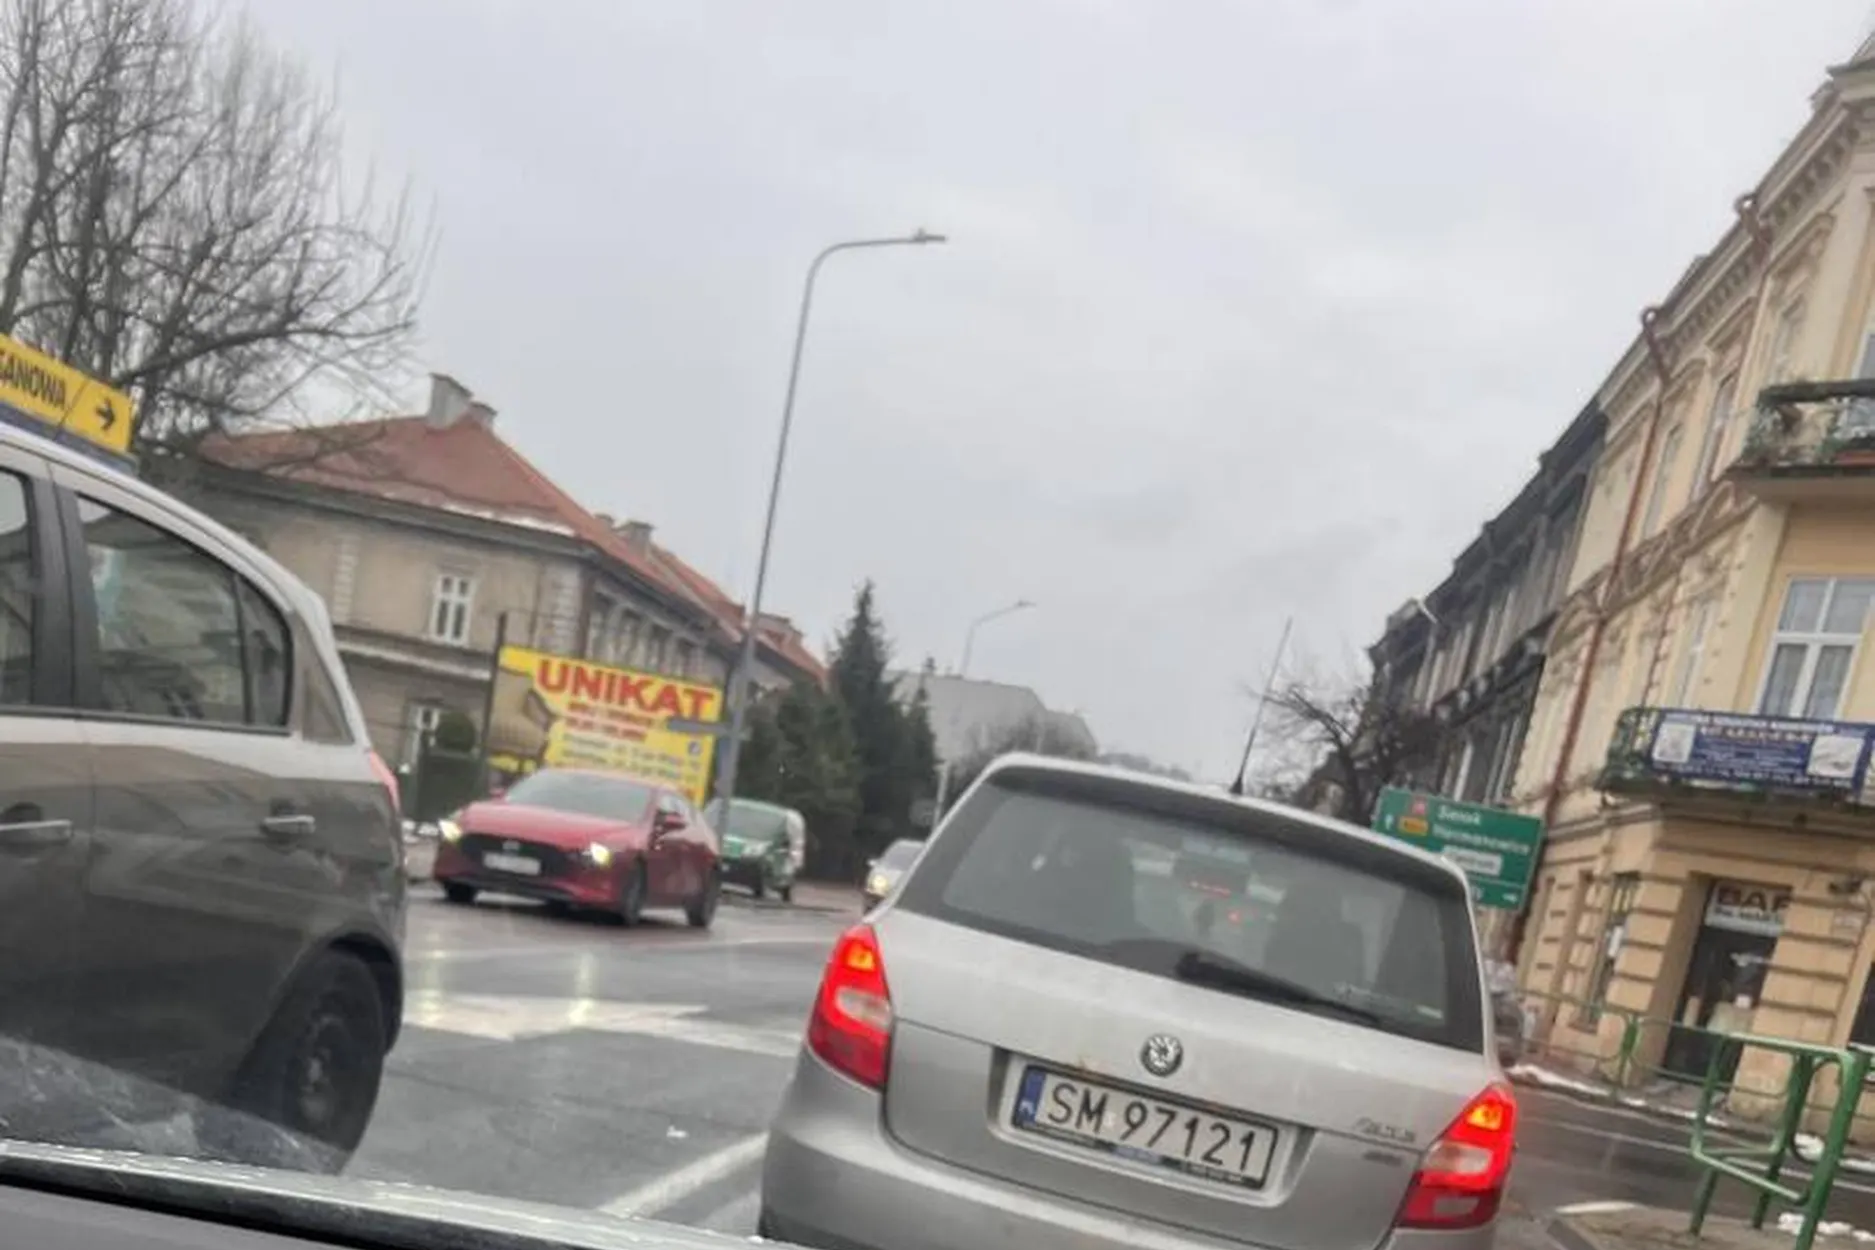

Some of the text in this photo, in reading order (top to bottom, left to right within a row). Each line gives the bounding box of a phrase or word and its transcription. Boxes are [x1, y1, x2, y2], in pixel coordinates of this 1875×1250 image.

[537, 659, 715, 717] UNIKAT
[1048, 1082, 1256, 1172] SM 97121
